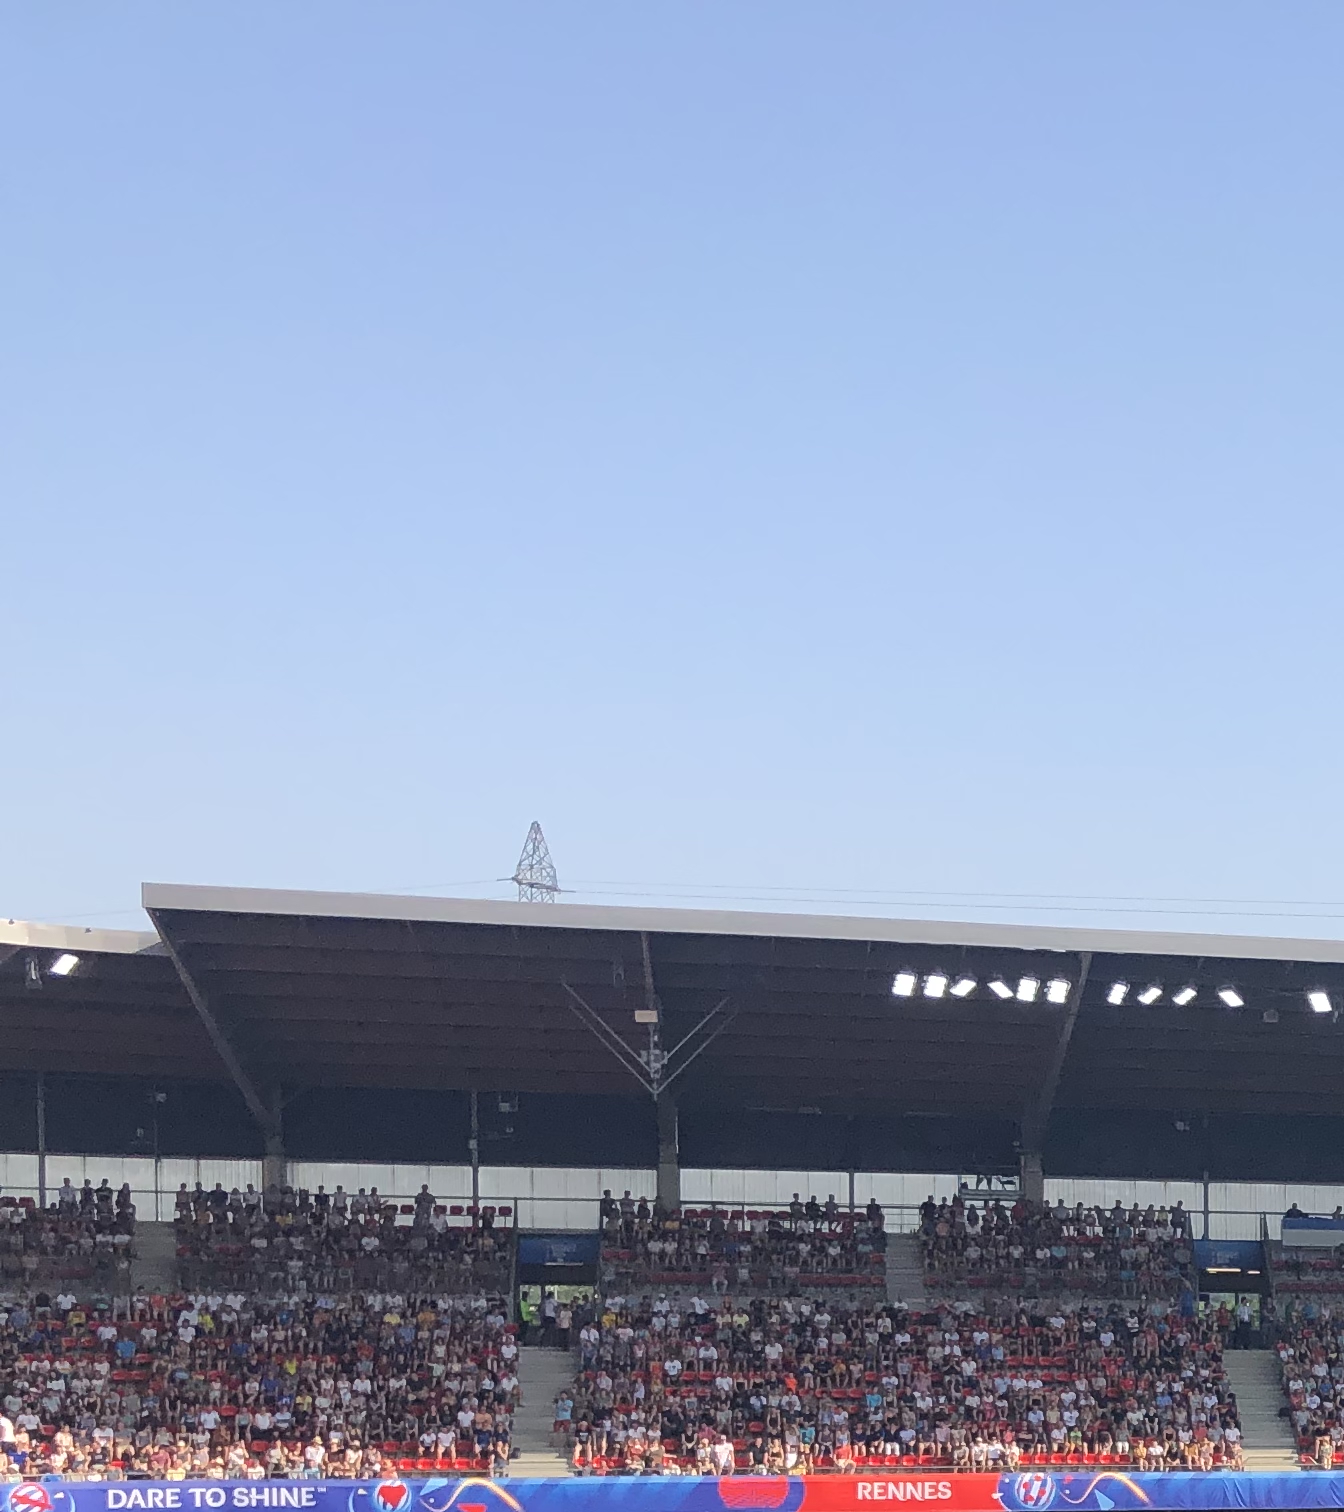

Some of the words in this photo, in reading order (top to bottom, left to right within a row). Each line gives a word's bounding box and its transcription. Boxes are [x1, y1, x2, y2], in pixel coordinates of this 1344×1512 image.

[108, 1487, 181, 1510] DARE
[189, 1487, 226, 1509] TO
[857, 1481, 952, 1501] RENNES
